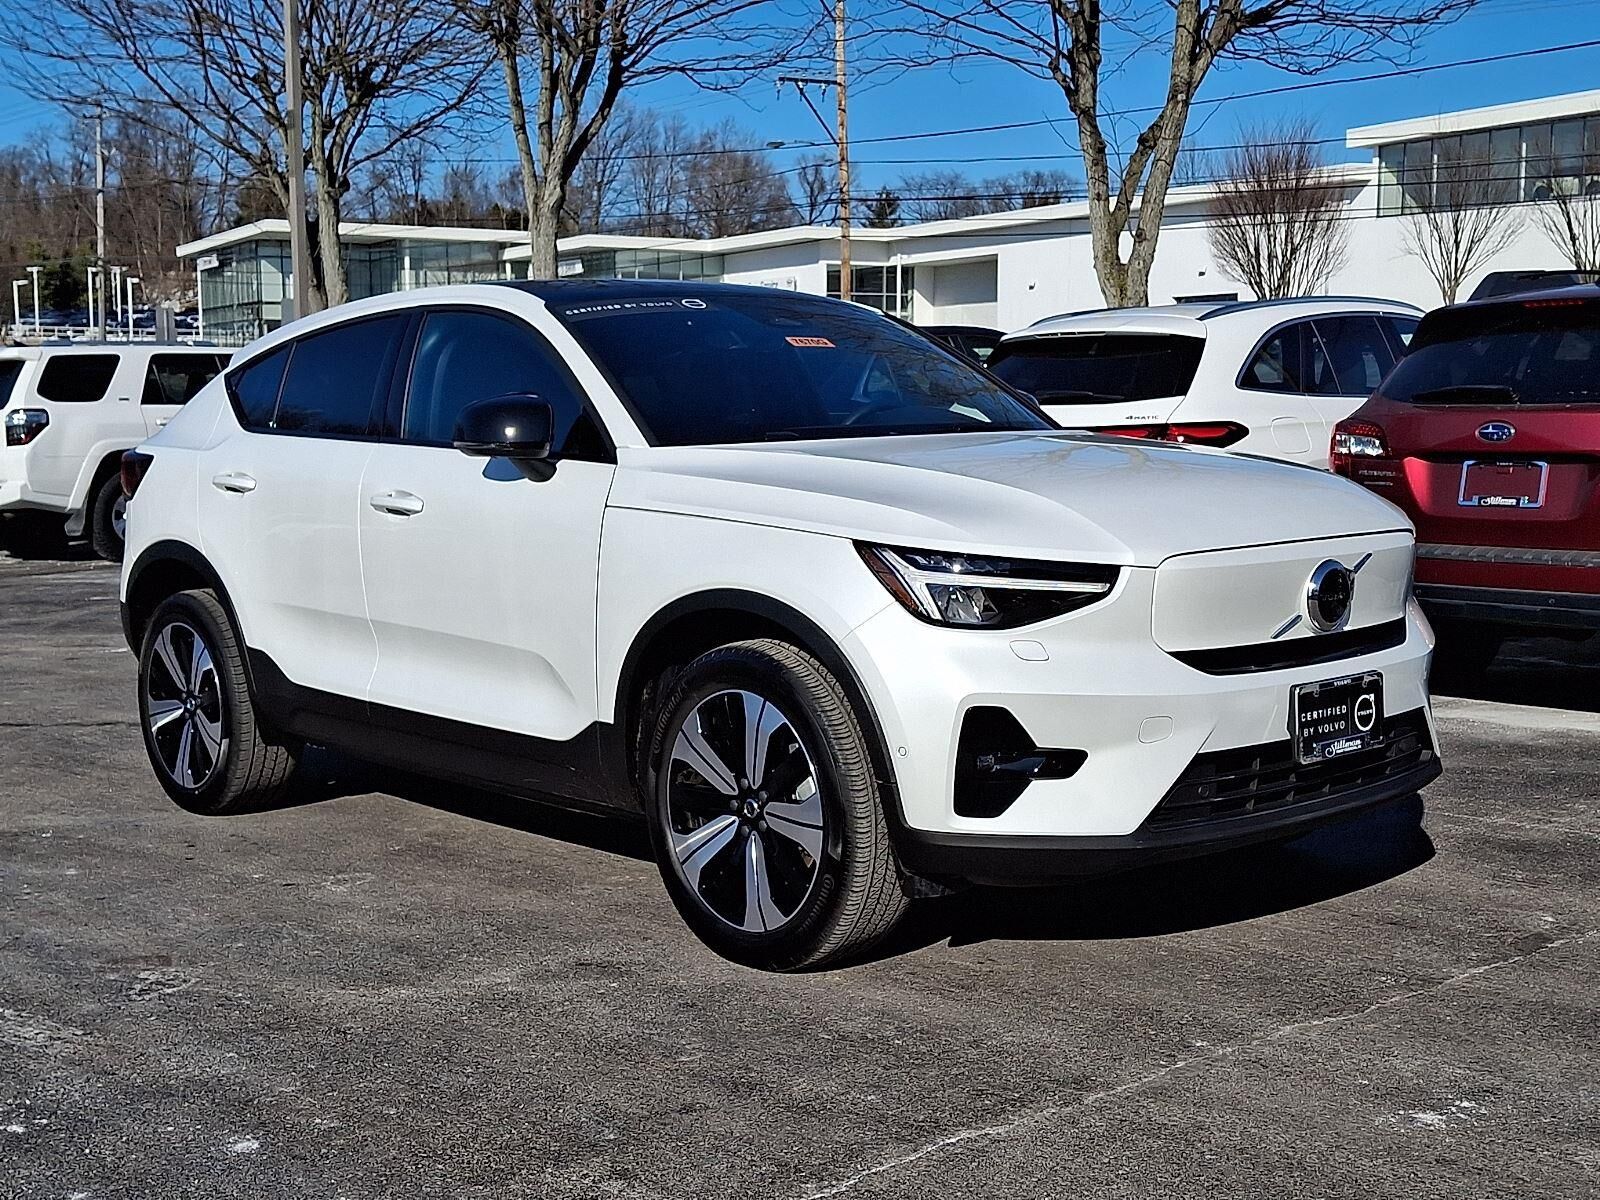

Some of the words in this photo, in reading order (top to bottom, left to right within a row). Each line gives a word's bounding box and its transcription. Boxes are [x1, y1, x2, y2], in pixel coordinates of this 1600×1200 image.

[565, 304, 621, 315] CERTIFIED
[1301, 705, 1347, 722] CERTIFIED
[1303, 726, 1315, 738] BY
[1318, 720, 1346, 734] VOLVO
[1325, 739, 1362, 757] Stillman
